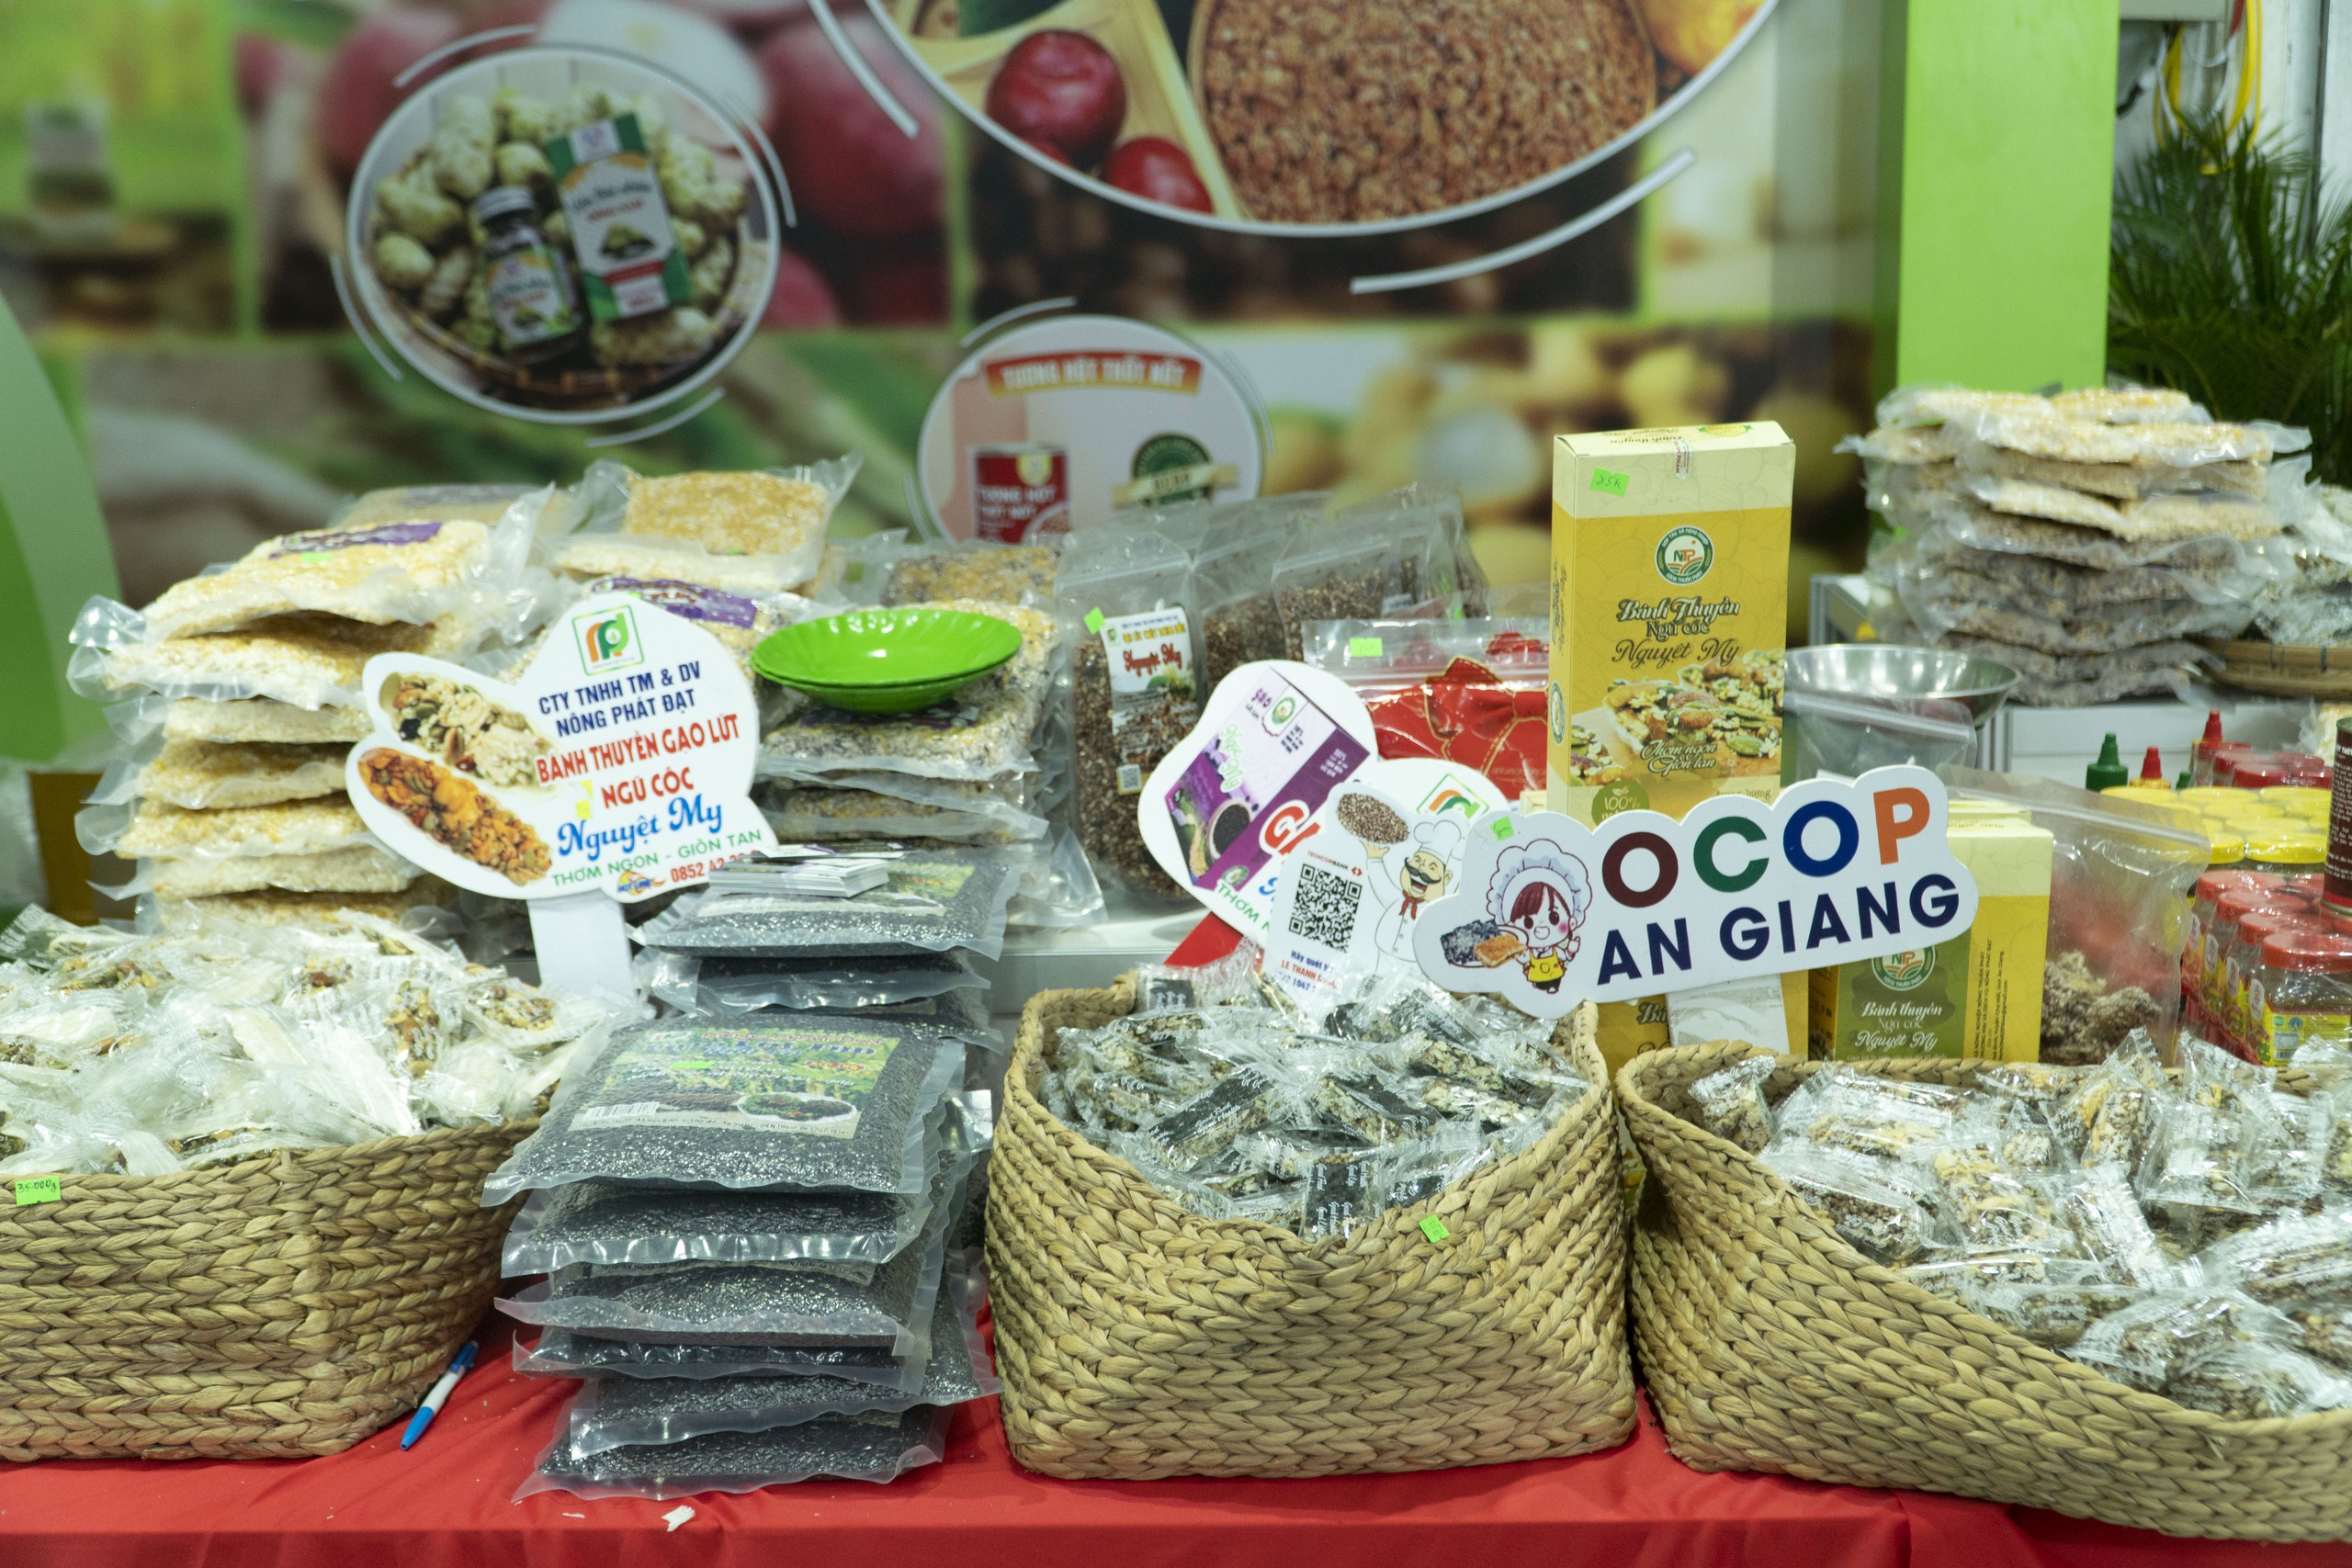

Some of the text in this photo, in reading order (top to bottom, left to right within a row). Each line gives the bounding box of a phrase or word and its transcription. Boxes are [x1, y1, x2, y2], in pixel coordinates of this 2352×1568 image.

[1617, 596, 1740, 625] Bánh Thuyền
[1611, 638, 1692, 670] Nguyệt
[538, 660, 701, 715] CTY TNHH TM & DV
[556, 689, 695, 737] NÔNG PHÁT ĐẠT
[536, 749, 588, 783] BÁNH
[589, 731, 659, 771] THUYỀN
[662, 723, 705, 754] GẠO
[601, 767, 694, 808] NGŨ CỐC
[558, 794, 722, 862] Nguyệt My
[1602, 787, 1931, 908] OCOP
[552, 865, 601, 886] THƠM
[608, 853, 659, 875] NGON
[678, 838, 722, 860] GIÒN
[727, 829, 762, 848] TAN
[671, 863, 706, 883] 0852
[1307, 851, 1349, 869] TECHCOMBANK
[1217, 883, 1260, 923] THƠM
[1597, 873, 1960, 986] AN GIANG
